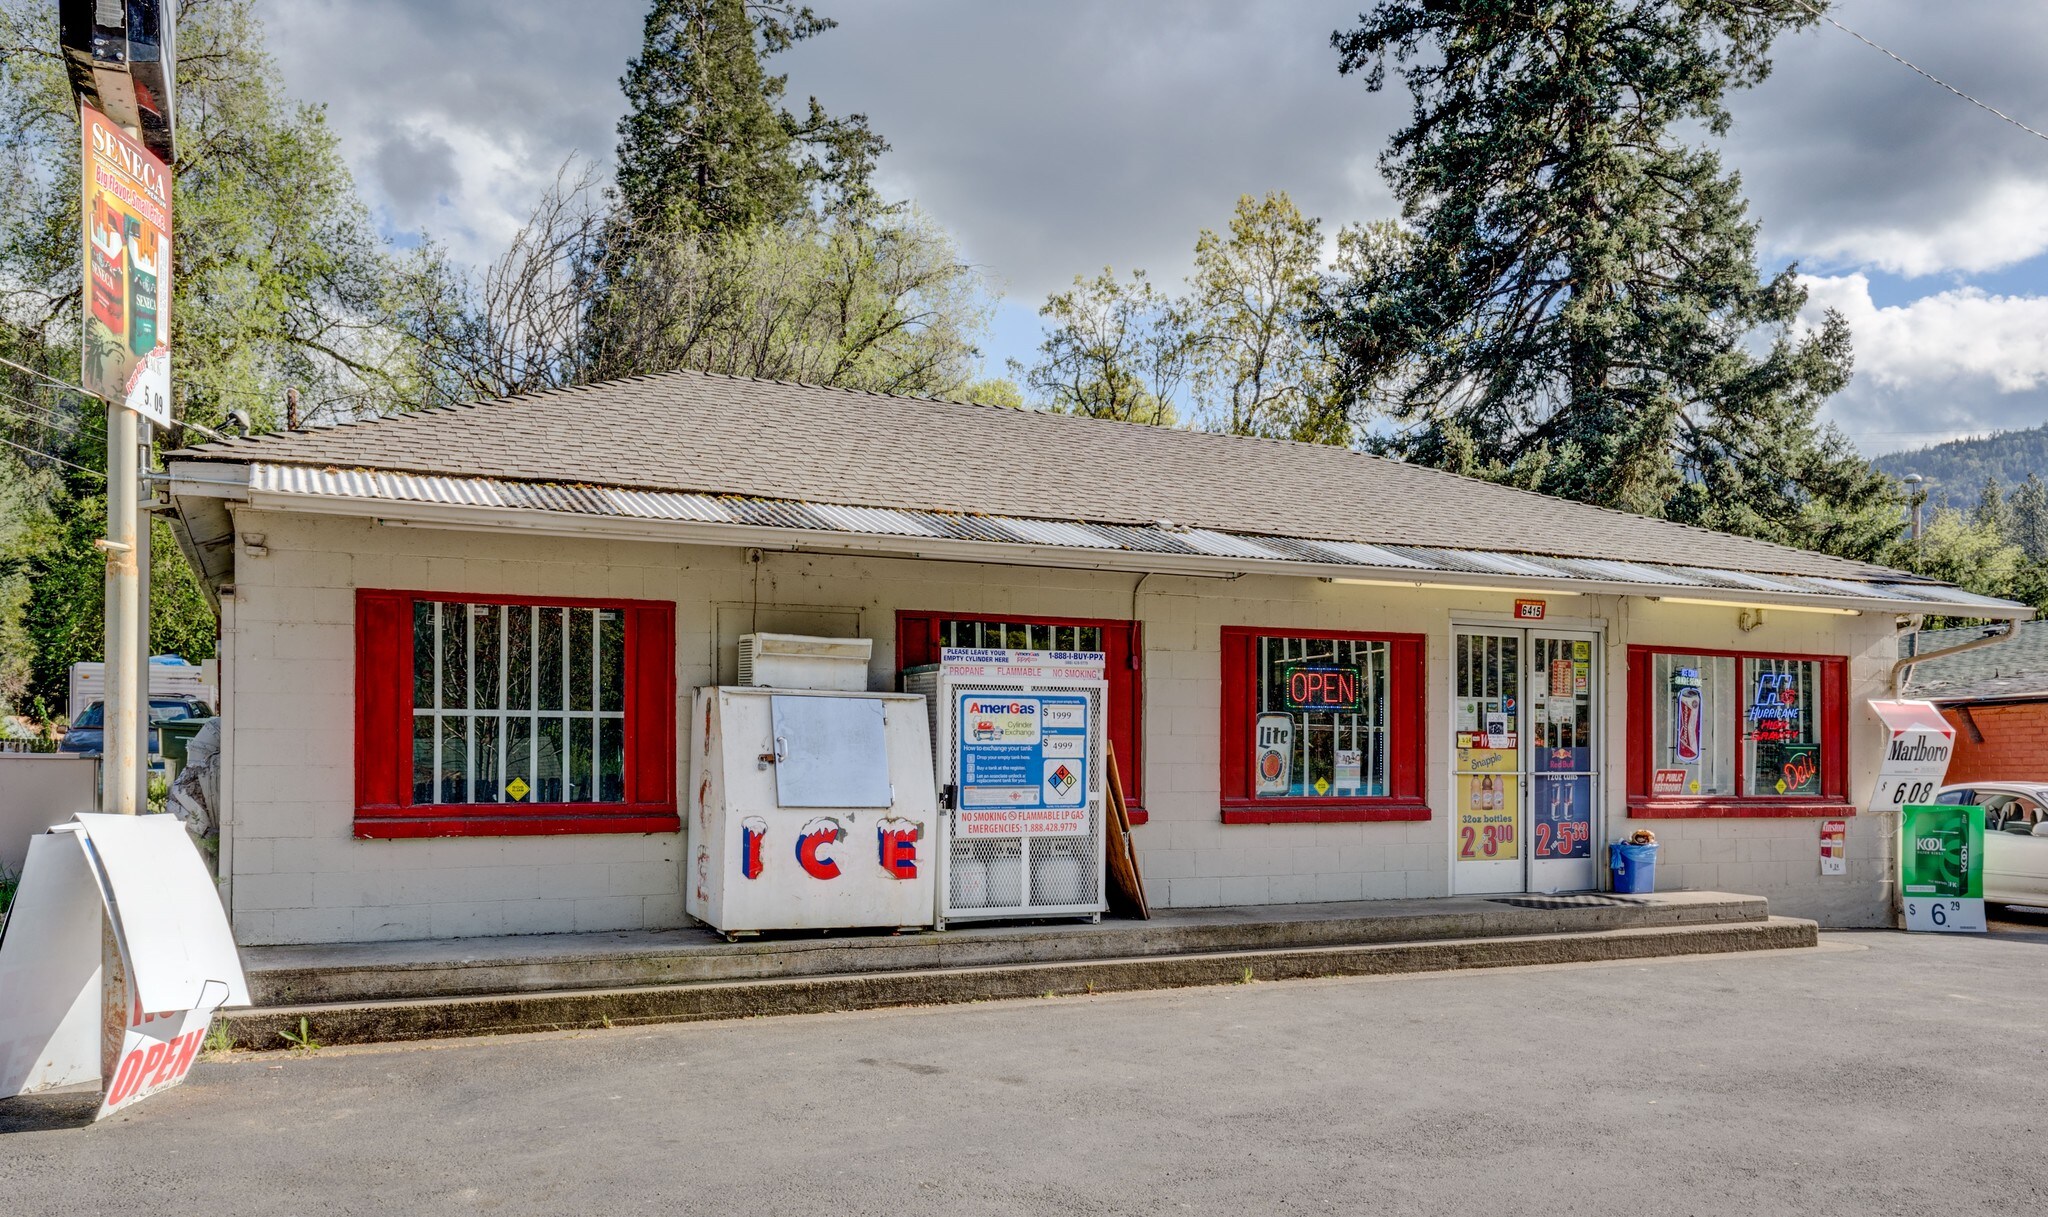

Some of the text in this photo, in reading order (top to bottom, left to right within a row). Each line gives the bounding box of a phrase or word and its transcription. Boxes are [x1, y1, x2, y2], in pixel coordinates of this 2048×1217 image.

[92, 122, 166, 201] SENECA
[96, 163, 108, 191] Big
[108, 173, 131, 206] Flavor.
[131, 190, 150, 218] Small
[92, 260, 114, 290] SENECA
[136, 294, 157, 311] SENECA
[1522, 605, 1541, 617] 6415
[947, 648, 968, 656] PLEASE
[1049, 651, 1104, 661] 1-888-I-BUY-PPX
[965, 655, 993, 663] CYLINDER
[994, 656, 1009, 664] HERE
[950, 666, 985, 676] PROPANE
[997, 667, 1042, 677] FLAMMABLE
[1052, 668, 1097, 679] NO SMOKING
[1291, 672, 1354, 703] OPEN
[969, 702, 1036, 715] AmeriGas
[1043, 707, 1072, 720] $ 1999
[1749, 706, 1800, 721] HURRICANE
[1007, 720, 1033, 730] Cylinder
[1005, 729, 1035, 738] Exchange
[1258, 726, 1288, 749] Lite
[983, 745, 1007, 753] exchange
[1043, 738, 1073, 750] $ 4999
[1888, 735, 1948, 761] Marlboro
[1471, 752, 1502, 770] Snapple
[1549, 760, 1574, 769] Red Bull
[1059, 767, 1065, 776] 4
[1784, 751, 1816, 790] Deli
[1053, 775, 1073, 785] 1 0
[1881, 781, 1933, 804] $ 6.08
[962, 810, 1084, 822] NO SMOKING FLAMMABLE LP GAS
[1462, 814, 1513, 824] 32oz bottles
[968, 822, 1078, 834] EMERGENCIES: 1.888.428.9779
[1461, 826, 1476, 858] 2
[1536, 822, 1551, 856] 2
[1916, 837, 1947, 852] KOOL
[741, 815, 918, 880] ICE
[1960, 842, 1968, 873] KOOL
[1909, 904, 1916, 916] $
[107, 1028, 205, 1107] OPEN
